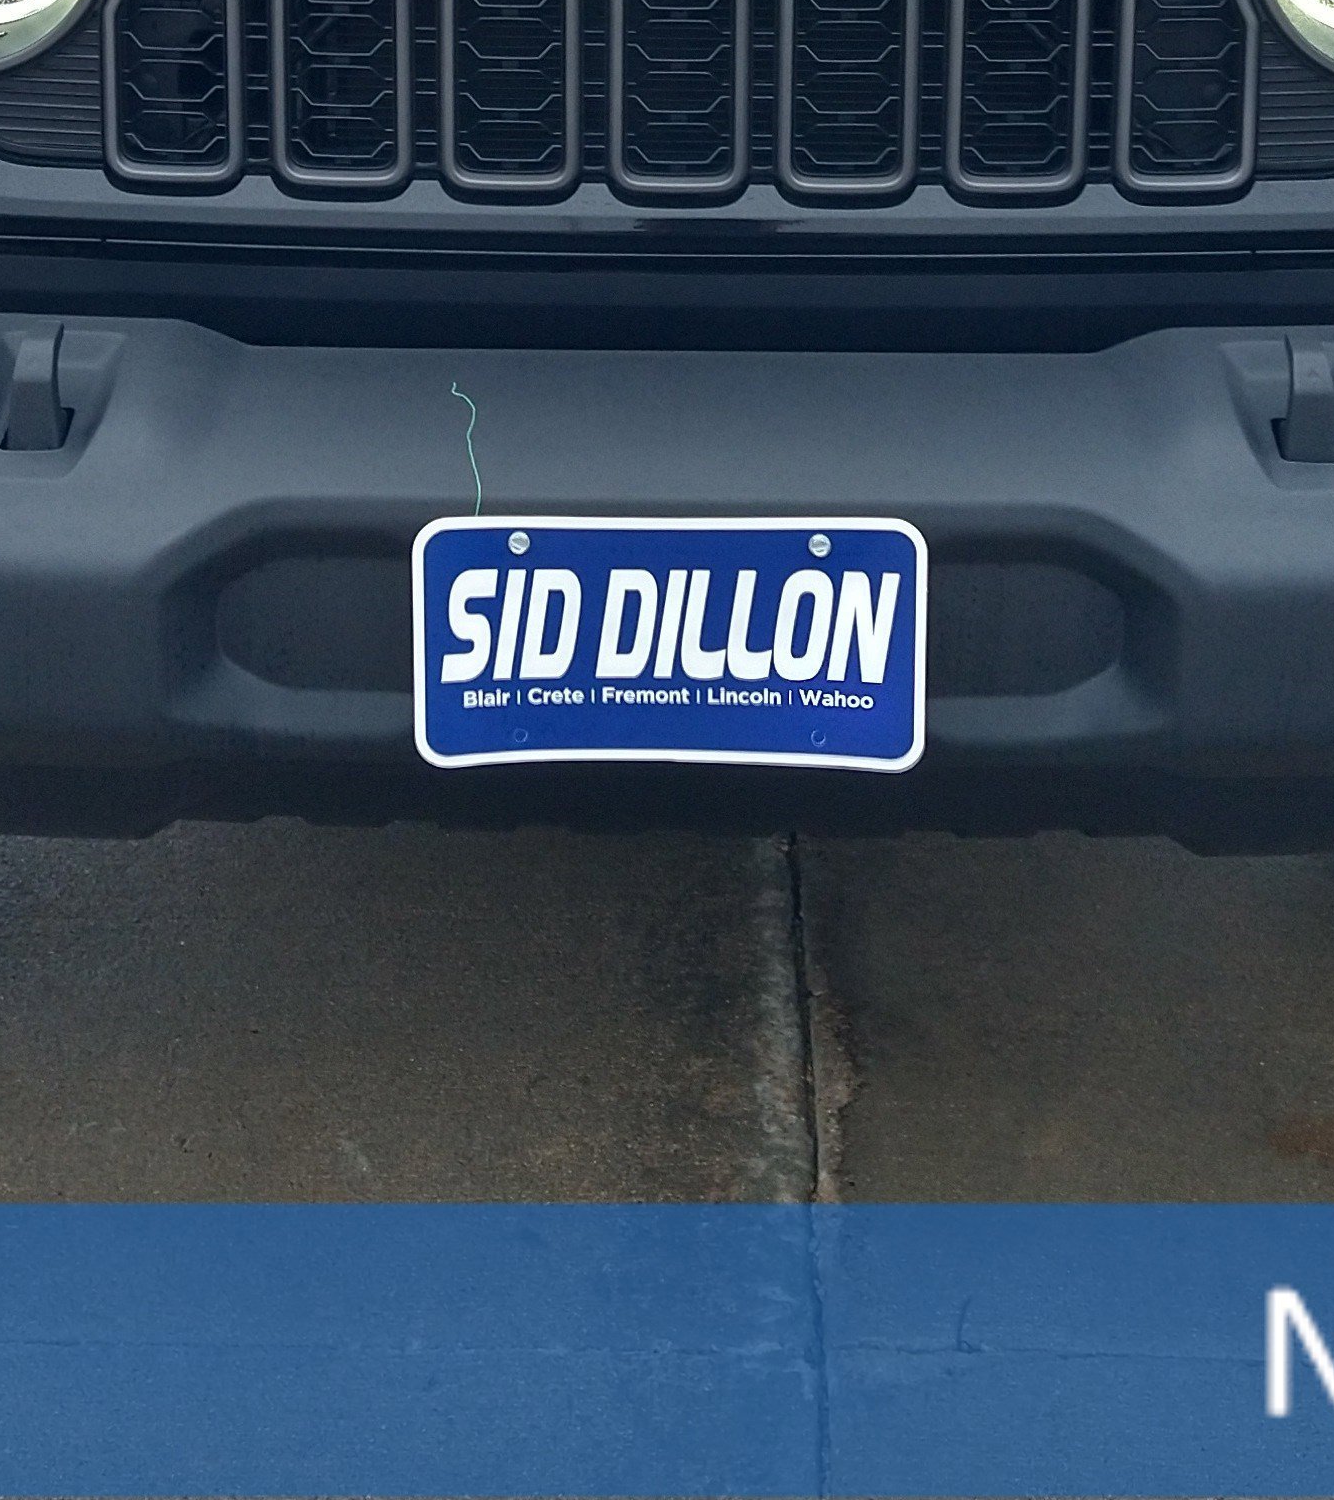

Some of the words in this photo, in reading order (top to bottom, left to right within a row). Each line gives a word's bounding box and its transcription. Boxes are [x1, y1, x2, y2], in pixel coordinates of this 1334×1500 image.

[441, 569, 582, 683] SID
[595, 569, 901, 684] DILLON
[463, 689, 511, 708] Blair
[527, 687, 585, 705] Crete
[602, 686, 690, 705] Fremont
[707, 687, 782, 706] Lincoln
[798, 688, 874, 709] Wahoo
